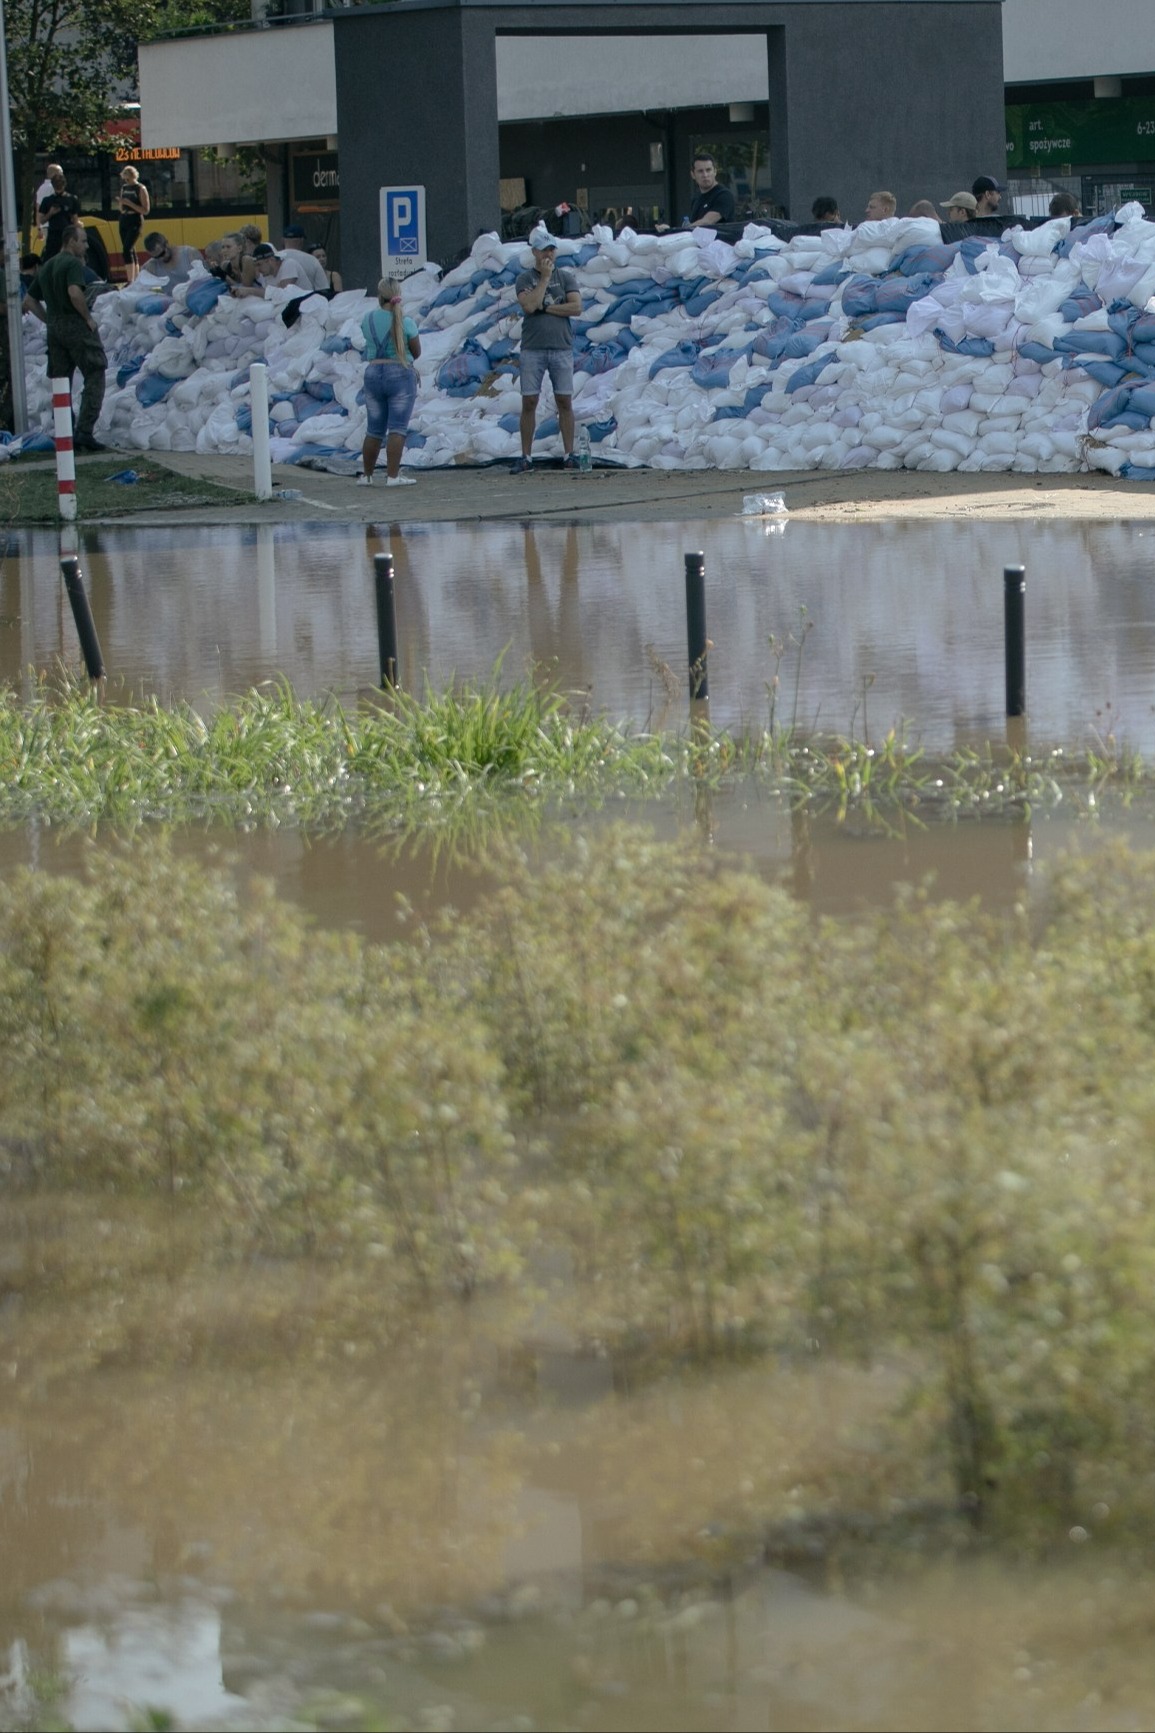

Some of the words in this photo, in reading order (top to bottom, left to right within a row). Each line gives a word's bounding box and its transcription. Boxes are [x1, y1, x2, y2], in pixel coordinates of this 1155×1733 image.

[1029, 120, 1043, 131] art.
[1029, 137, 1071, 154] spożywcze
[393, 197, 411, 238] P
[395, 257, 413, 265] Strefa
